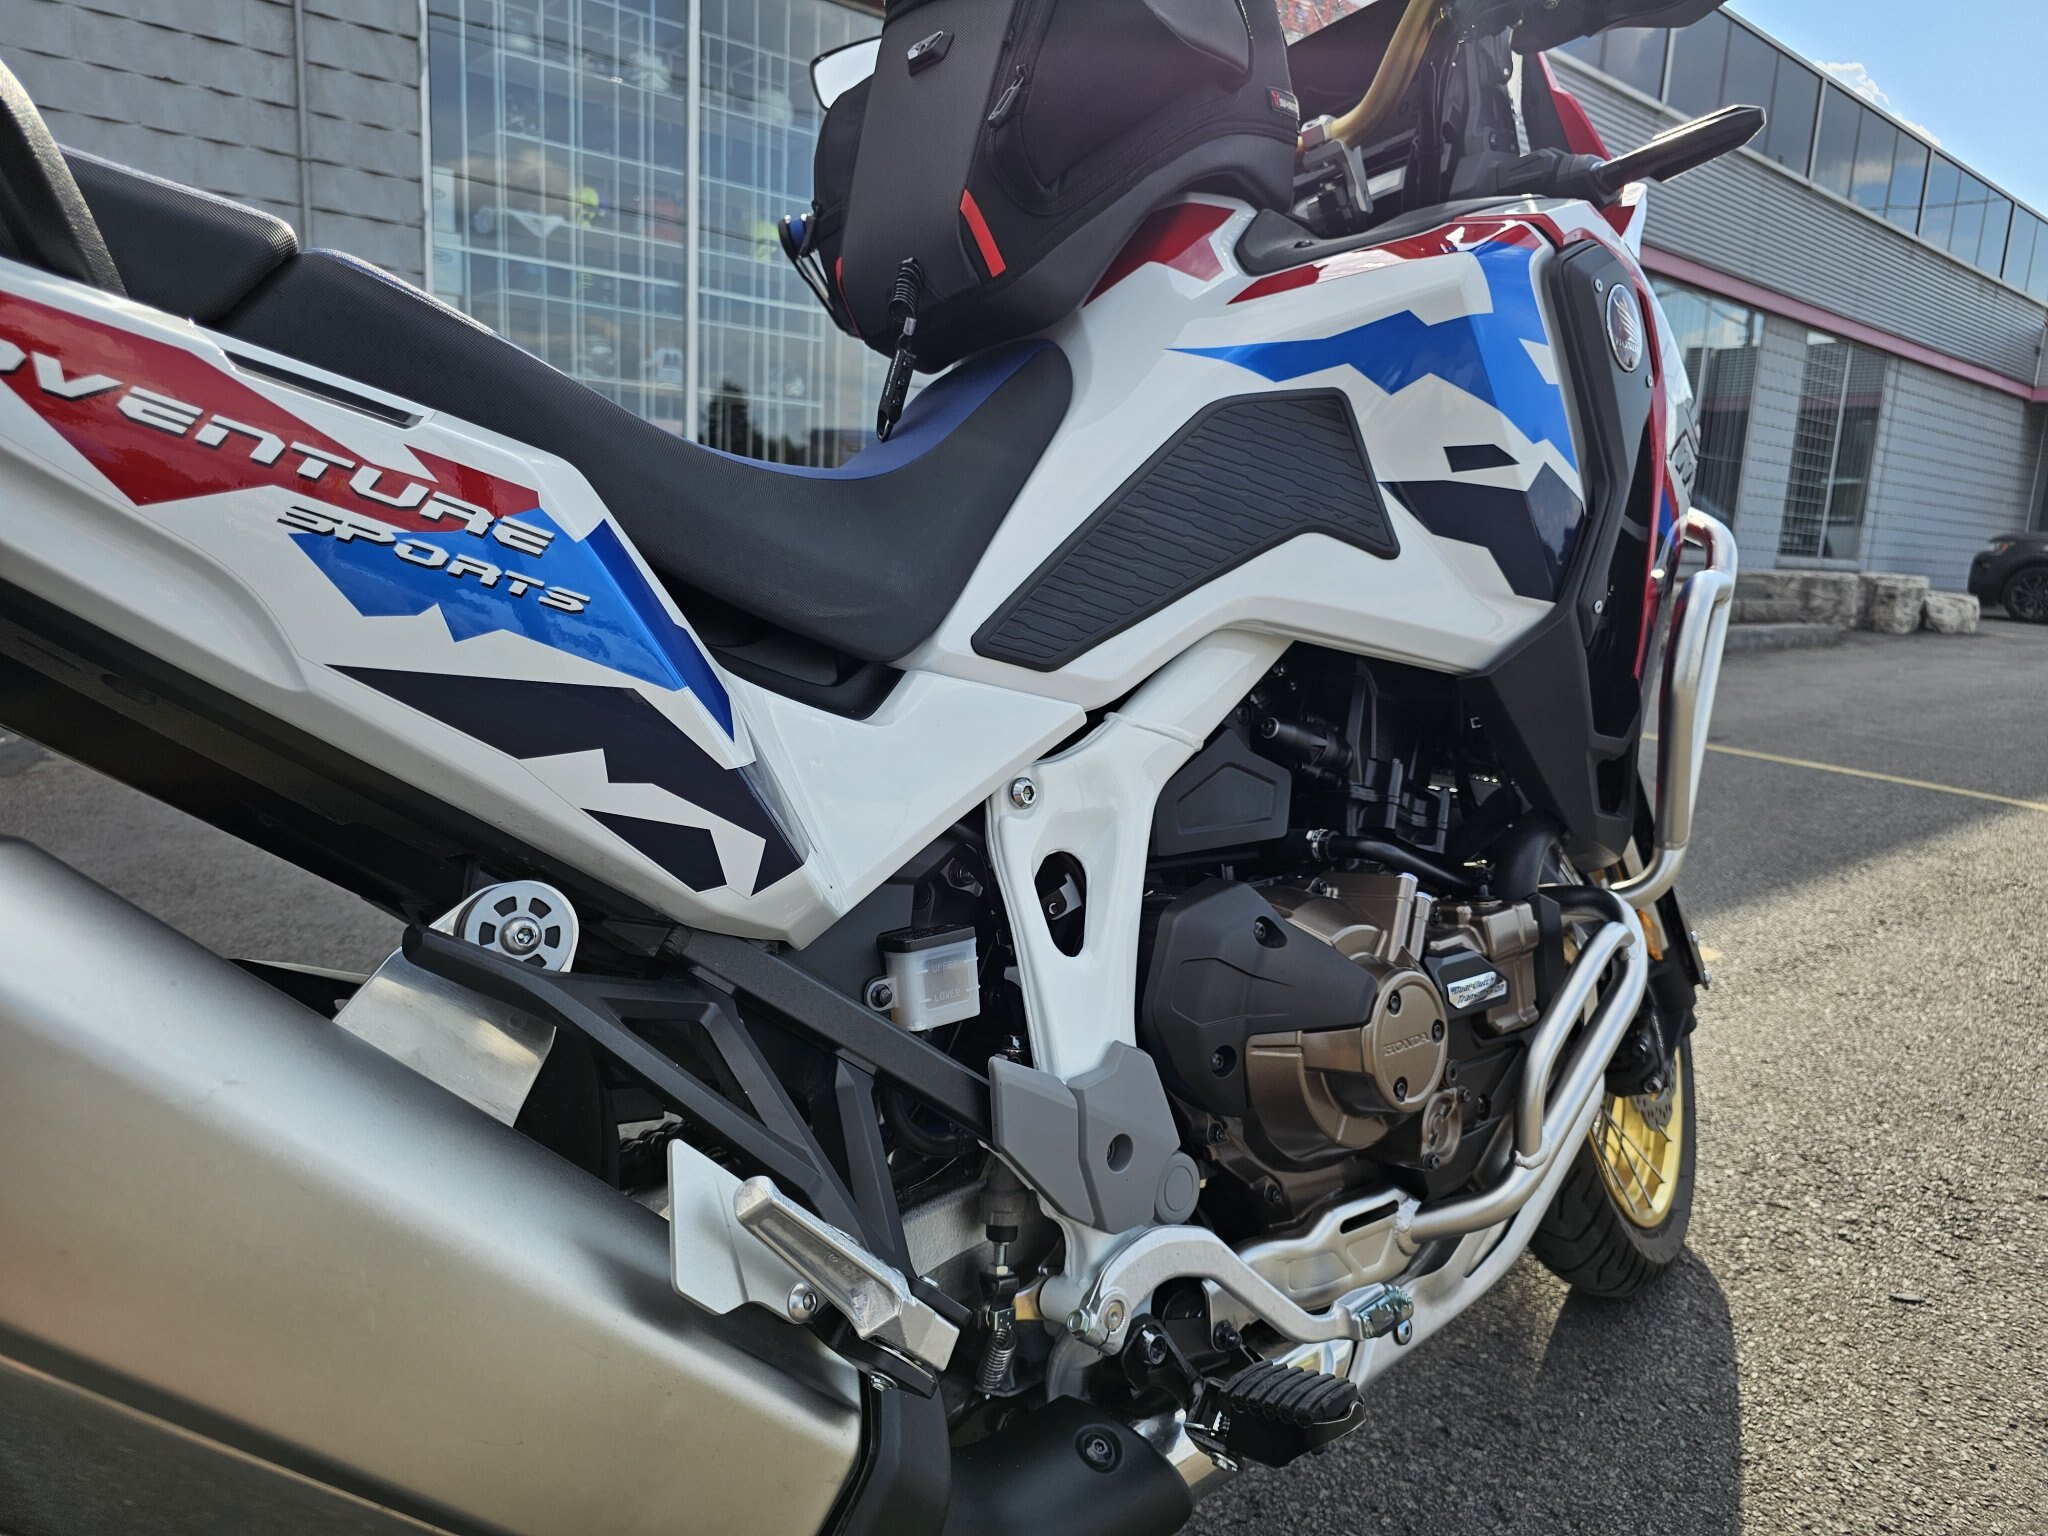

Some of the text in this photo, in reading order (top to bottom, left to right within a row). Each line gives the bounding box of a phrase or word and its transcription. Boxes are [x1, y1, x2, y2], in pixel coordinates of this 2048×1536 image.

[276, 505, 592, 613] SPORTS
[934, 987, 961, 1001] LOWER
[1384, 1032, 1430, 1057] HONDA
